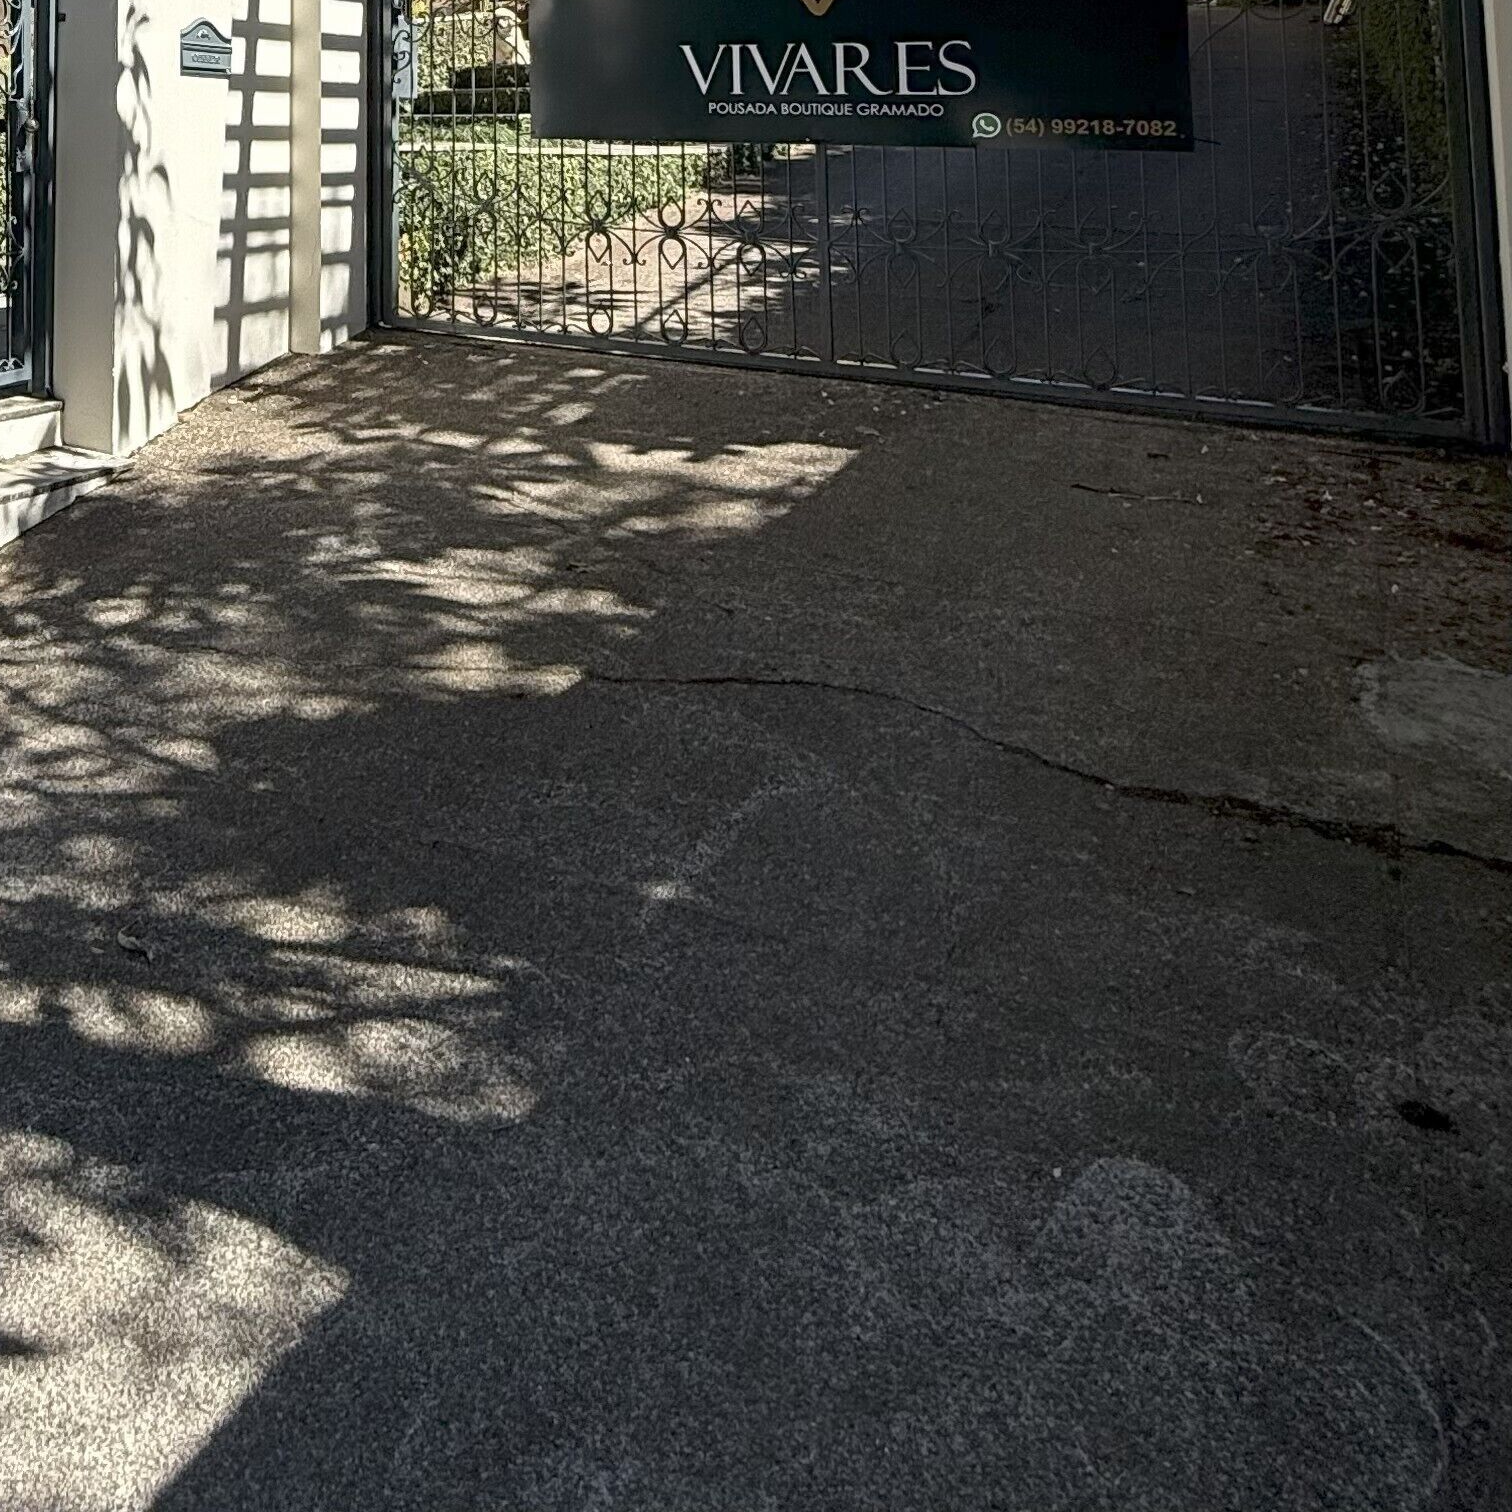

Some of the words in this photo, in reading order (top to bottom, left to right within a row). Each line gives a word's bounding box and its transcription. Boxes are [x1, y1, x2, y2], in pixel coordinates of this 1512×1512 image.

[678, 40, 976, 96] VIVARES
[708, 102, 778, 115] POUSADA
[781, 102, 854, 116] BOUTIQUE
[856, 102, 945, 117] GRAMADO
[1006, 118, 1044, 136] (54)
[1051, 118, 1177, 136] 99218-7082
